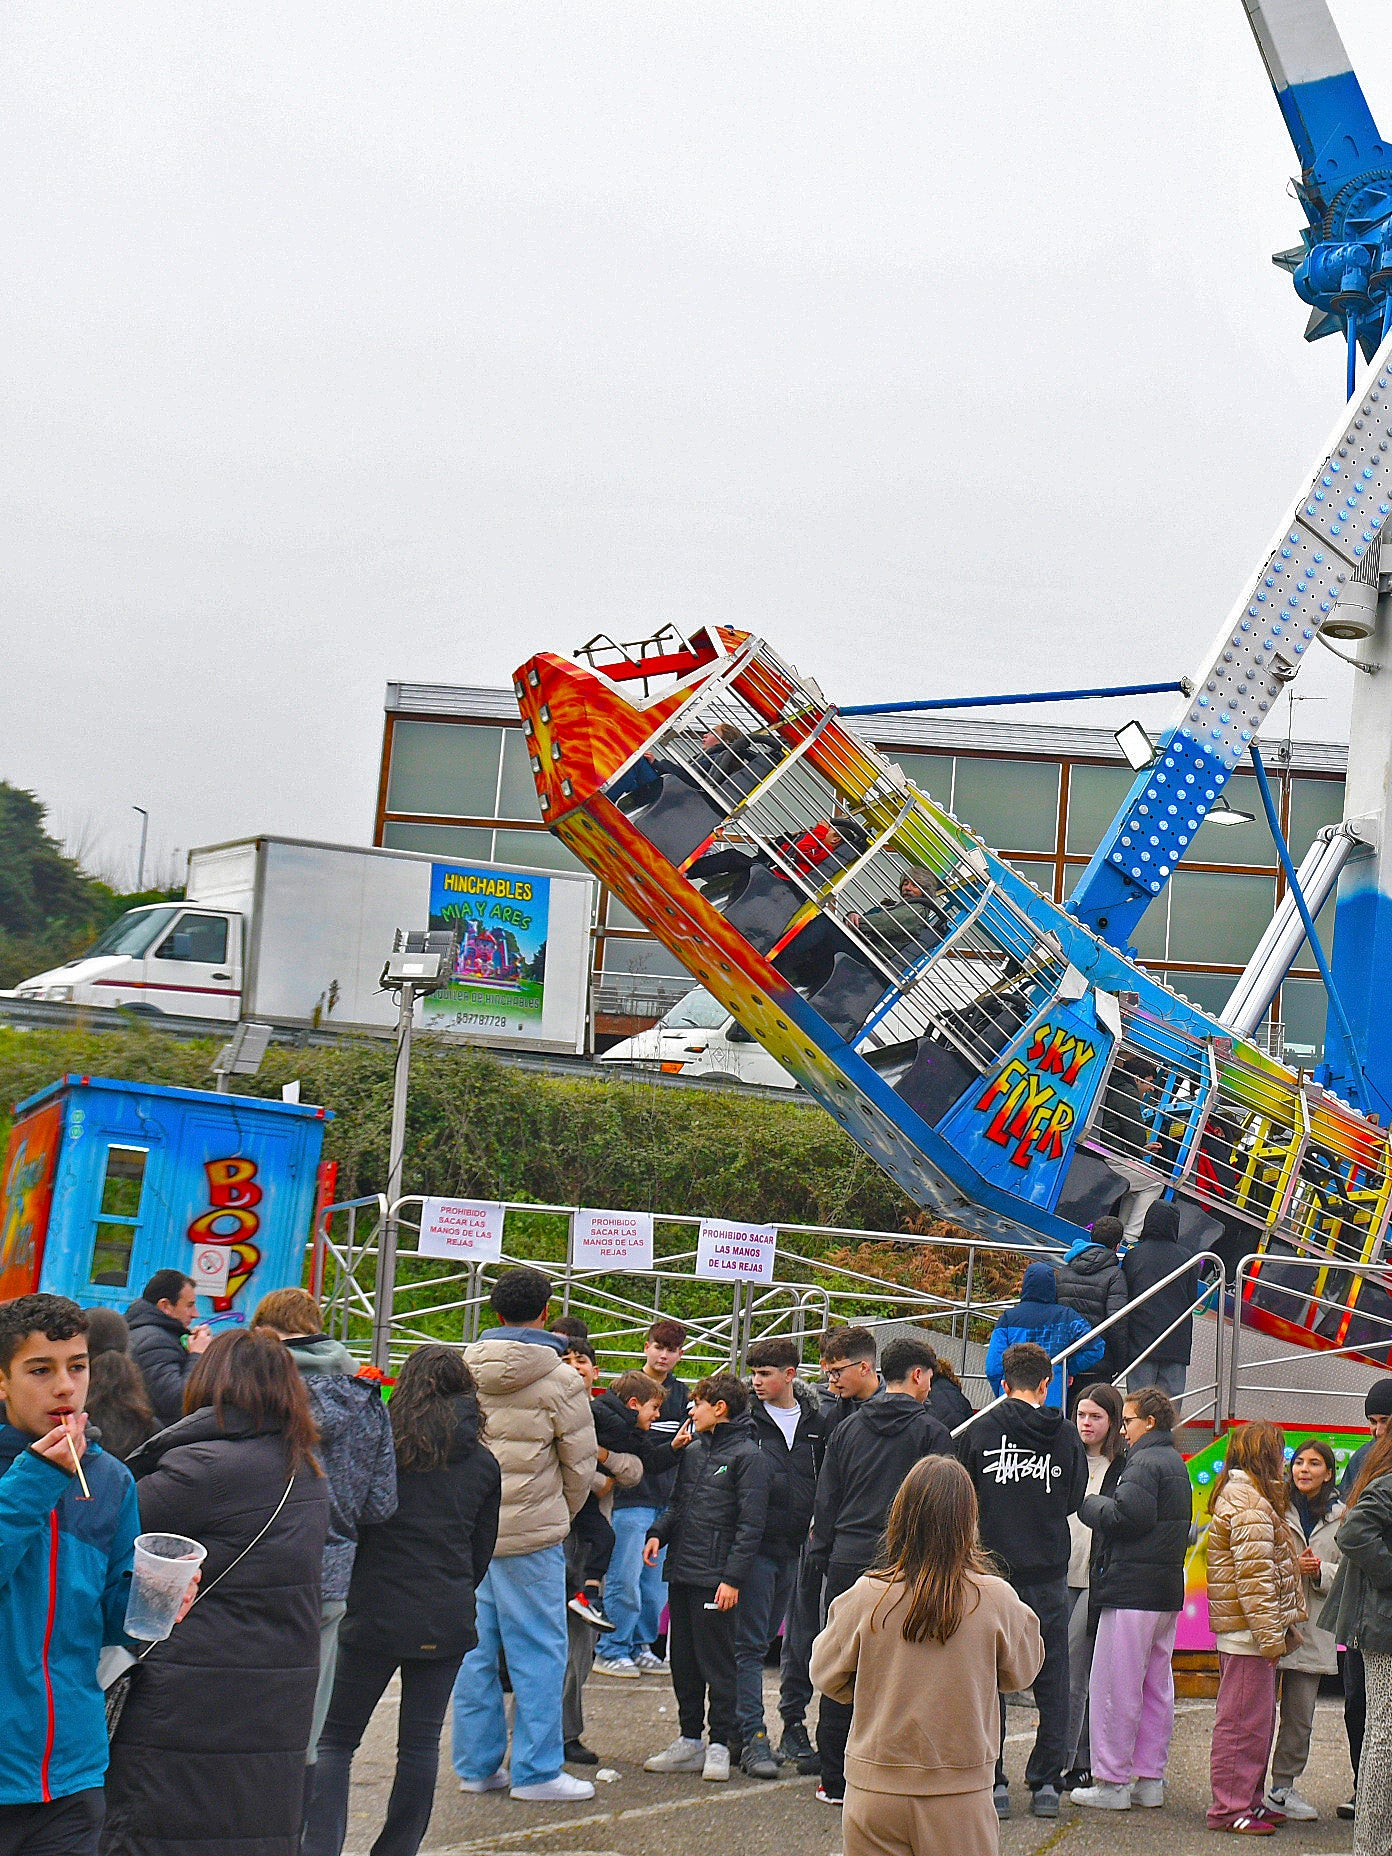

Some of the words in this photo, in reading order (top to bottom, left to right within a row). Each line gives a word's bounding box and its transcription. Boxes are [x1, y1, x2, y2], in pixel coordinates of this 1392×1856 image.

[443, 873, 533, 901] HINCHABLES
[441, 902, 473, 922] MIA
[475, 901, 488, 917] Y
[490, 904, 532, 931] ARES
[1027, 1022, 1096, 1087] SKY
[974, 1057, 1075, 1170] FLYER
[440, 1206, 487, 1218] PROHIBIDO
[438, 1216, 467, 1226] SACAR
[469, 1220, 485, 1228] LAS
[591, 1218, 637, 1226] PROHIBIDO
[430, 1226, 460, 1236] MANOS
[462, 1229, 473, 1237] DE
[475, 1231, 492, 1239] LAS
[590, 1228, 619, 1236] SACAR
[702, 1228, 748, 1241] PROHIBIDO
[749, 1233, 774, 1245] SACAR
[446, 1238, 473, 1247] REJAS
[582, 1238, 613, 1246] MANOS
[714, 1244, 730, 1254] LAS
[732, 1246, 761, 1258] MANOS
[708, 1258, 719, 1268] DE
[721, 1260, 737, 1270] LAS
[738, 1262, 763, 1273] REJAS
